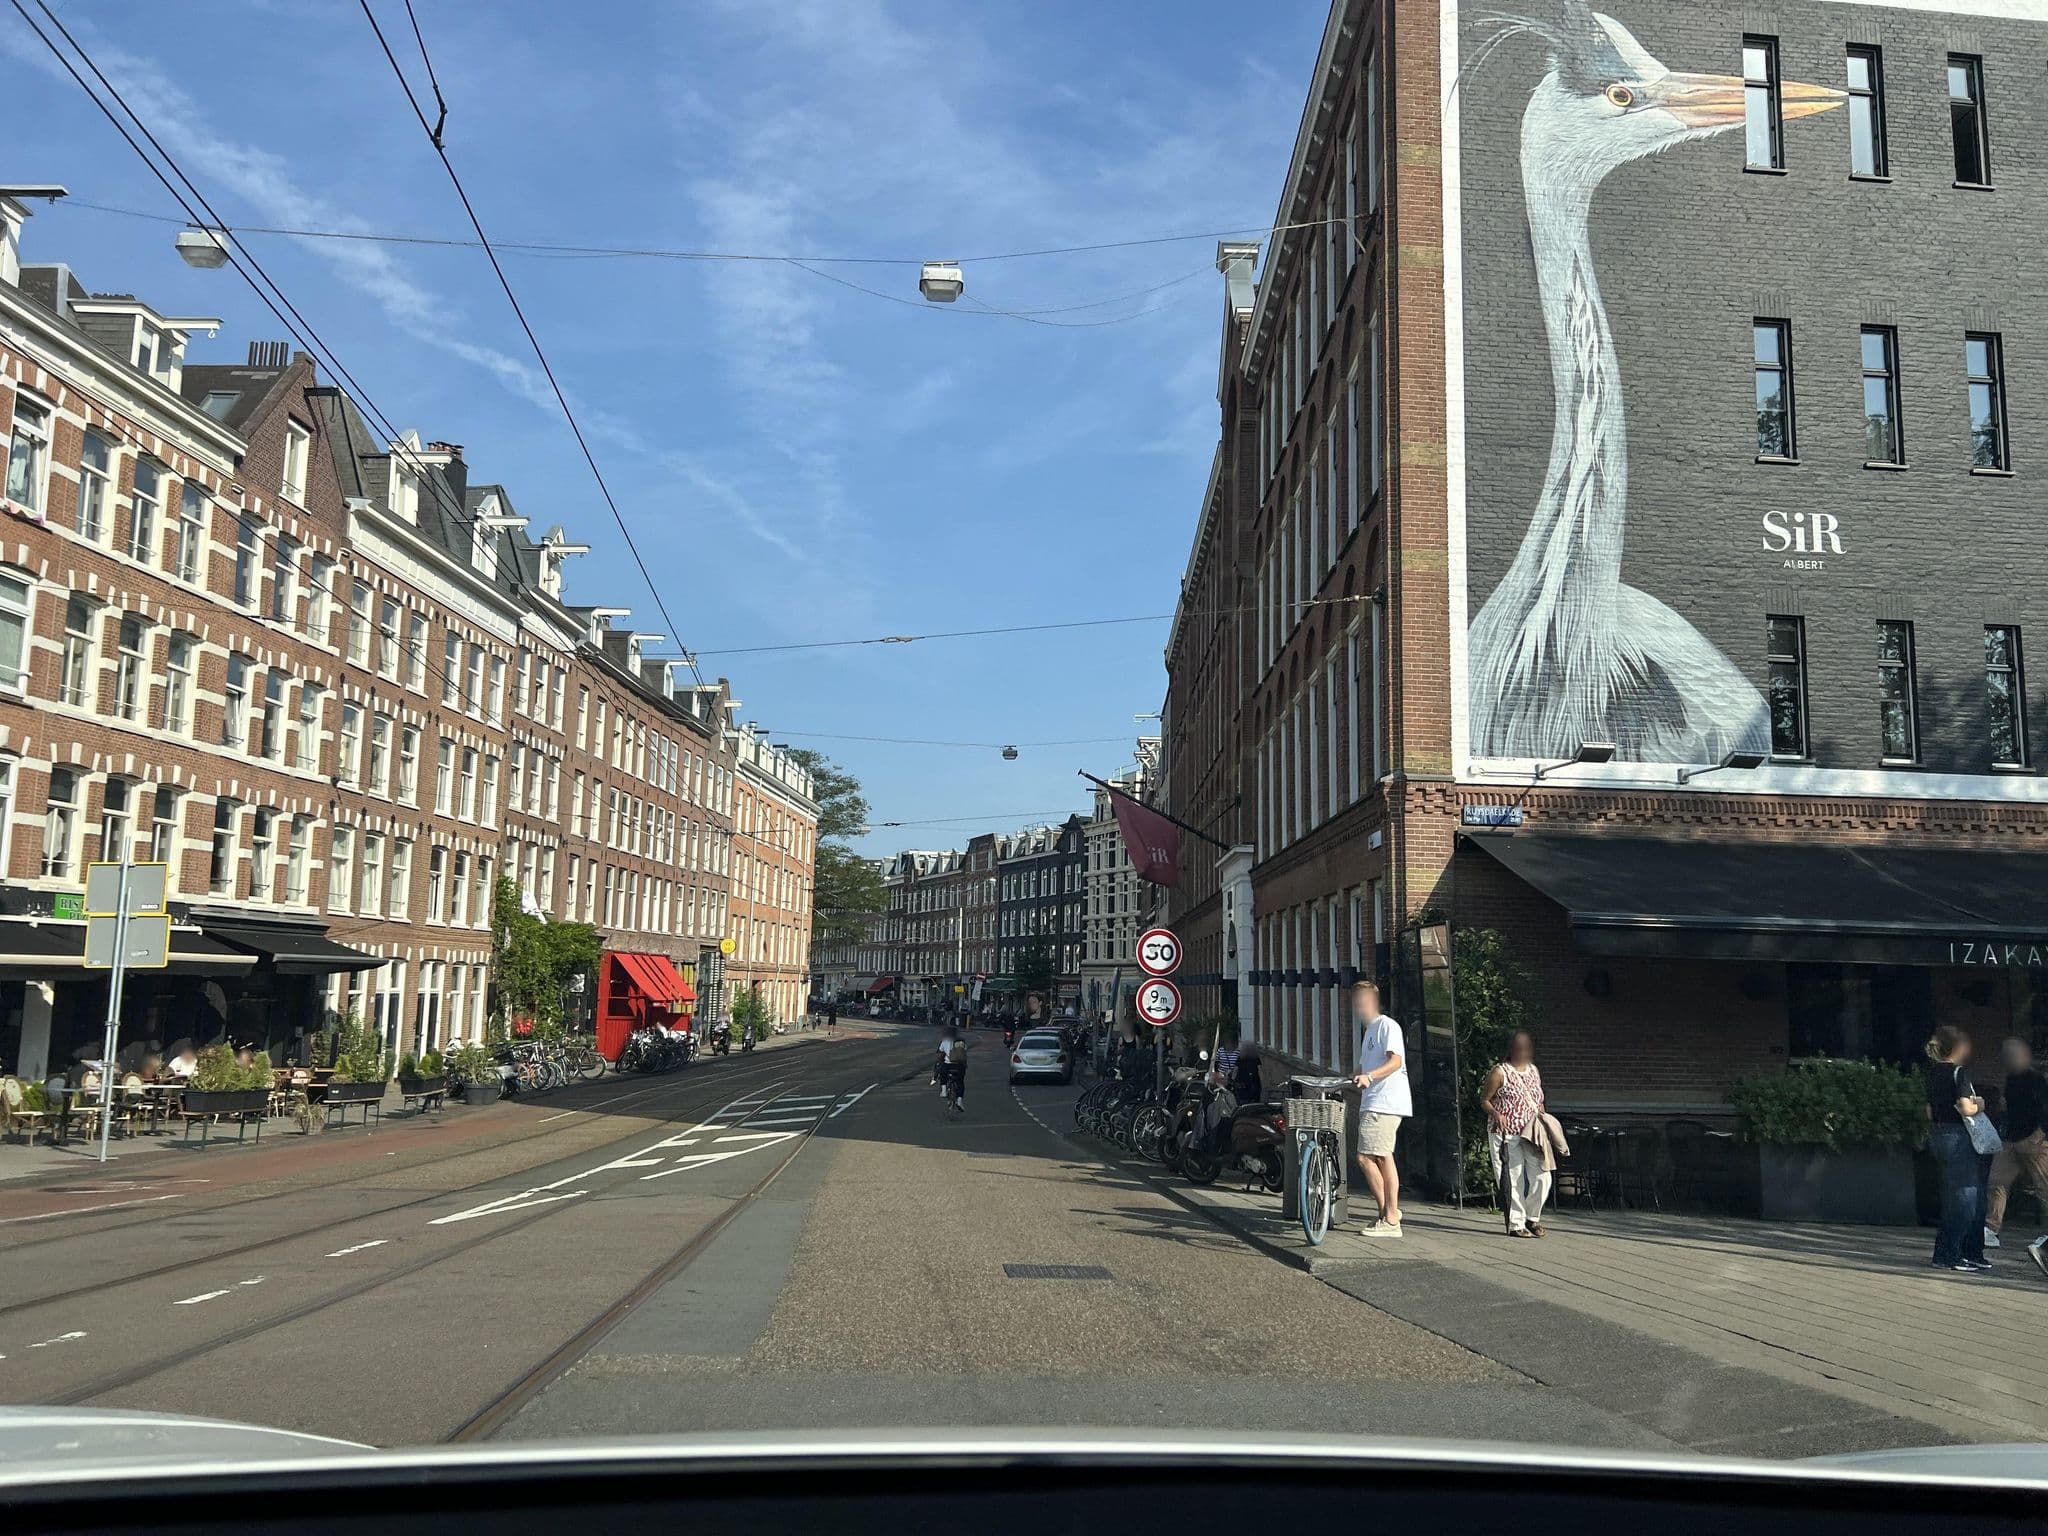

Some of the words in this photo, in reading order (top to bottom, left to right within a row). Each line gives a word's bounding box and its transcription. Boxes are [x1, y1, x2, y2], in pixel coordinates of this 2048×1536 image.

[1763, 511, 1847, 554] SiR
[1784, 560, 1824, 570] ALBERT
[1145, 943, 1175, 961] 30
[1950, 943, 2048, 966] IZAKA
[1151, 990, 1159, 1004] 9
